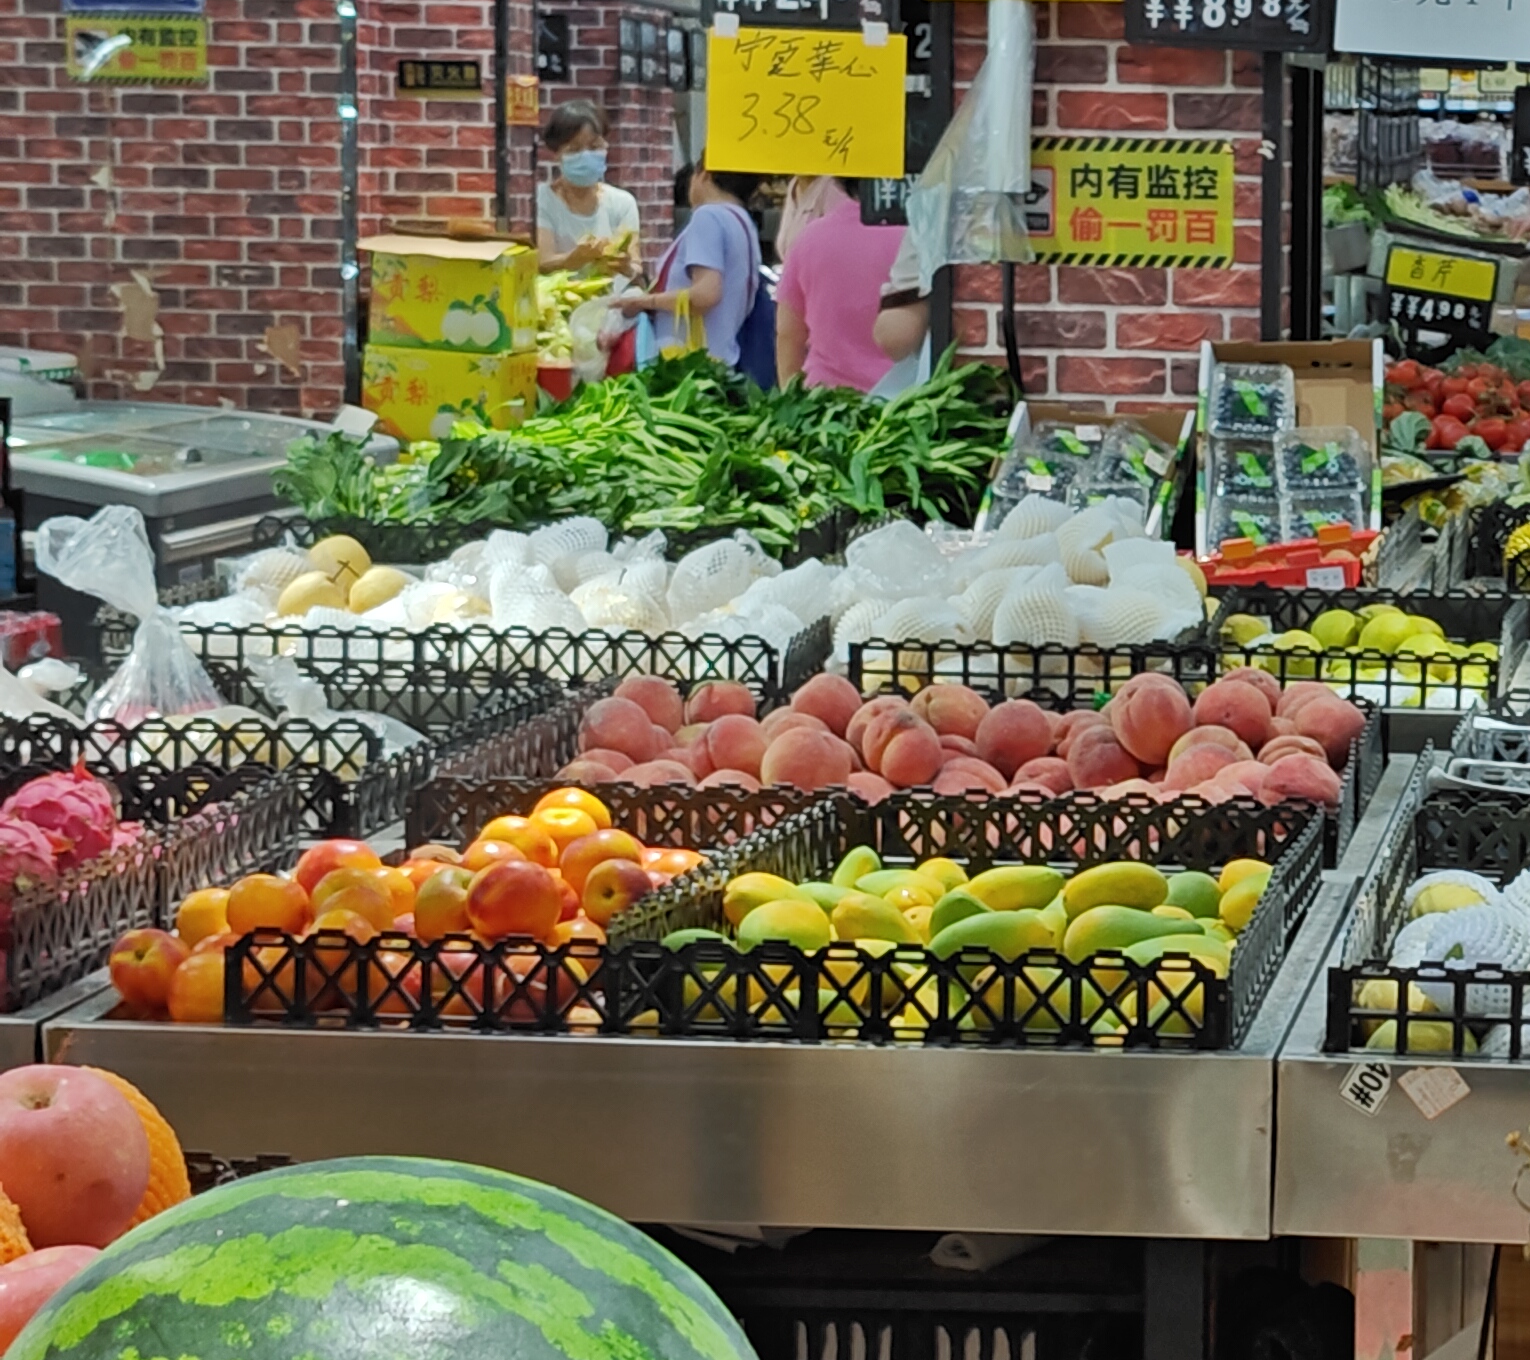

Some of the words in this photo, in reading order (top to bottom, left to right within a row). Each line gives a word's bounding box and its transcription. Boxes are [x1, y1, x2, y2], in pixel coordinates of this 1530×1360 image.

[1069, 162, 1220, 201] 内有监控
[1068, 206, 1218, 244] 偷一罚百
